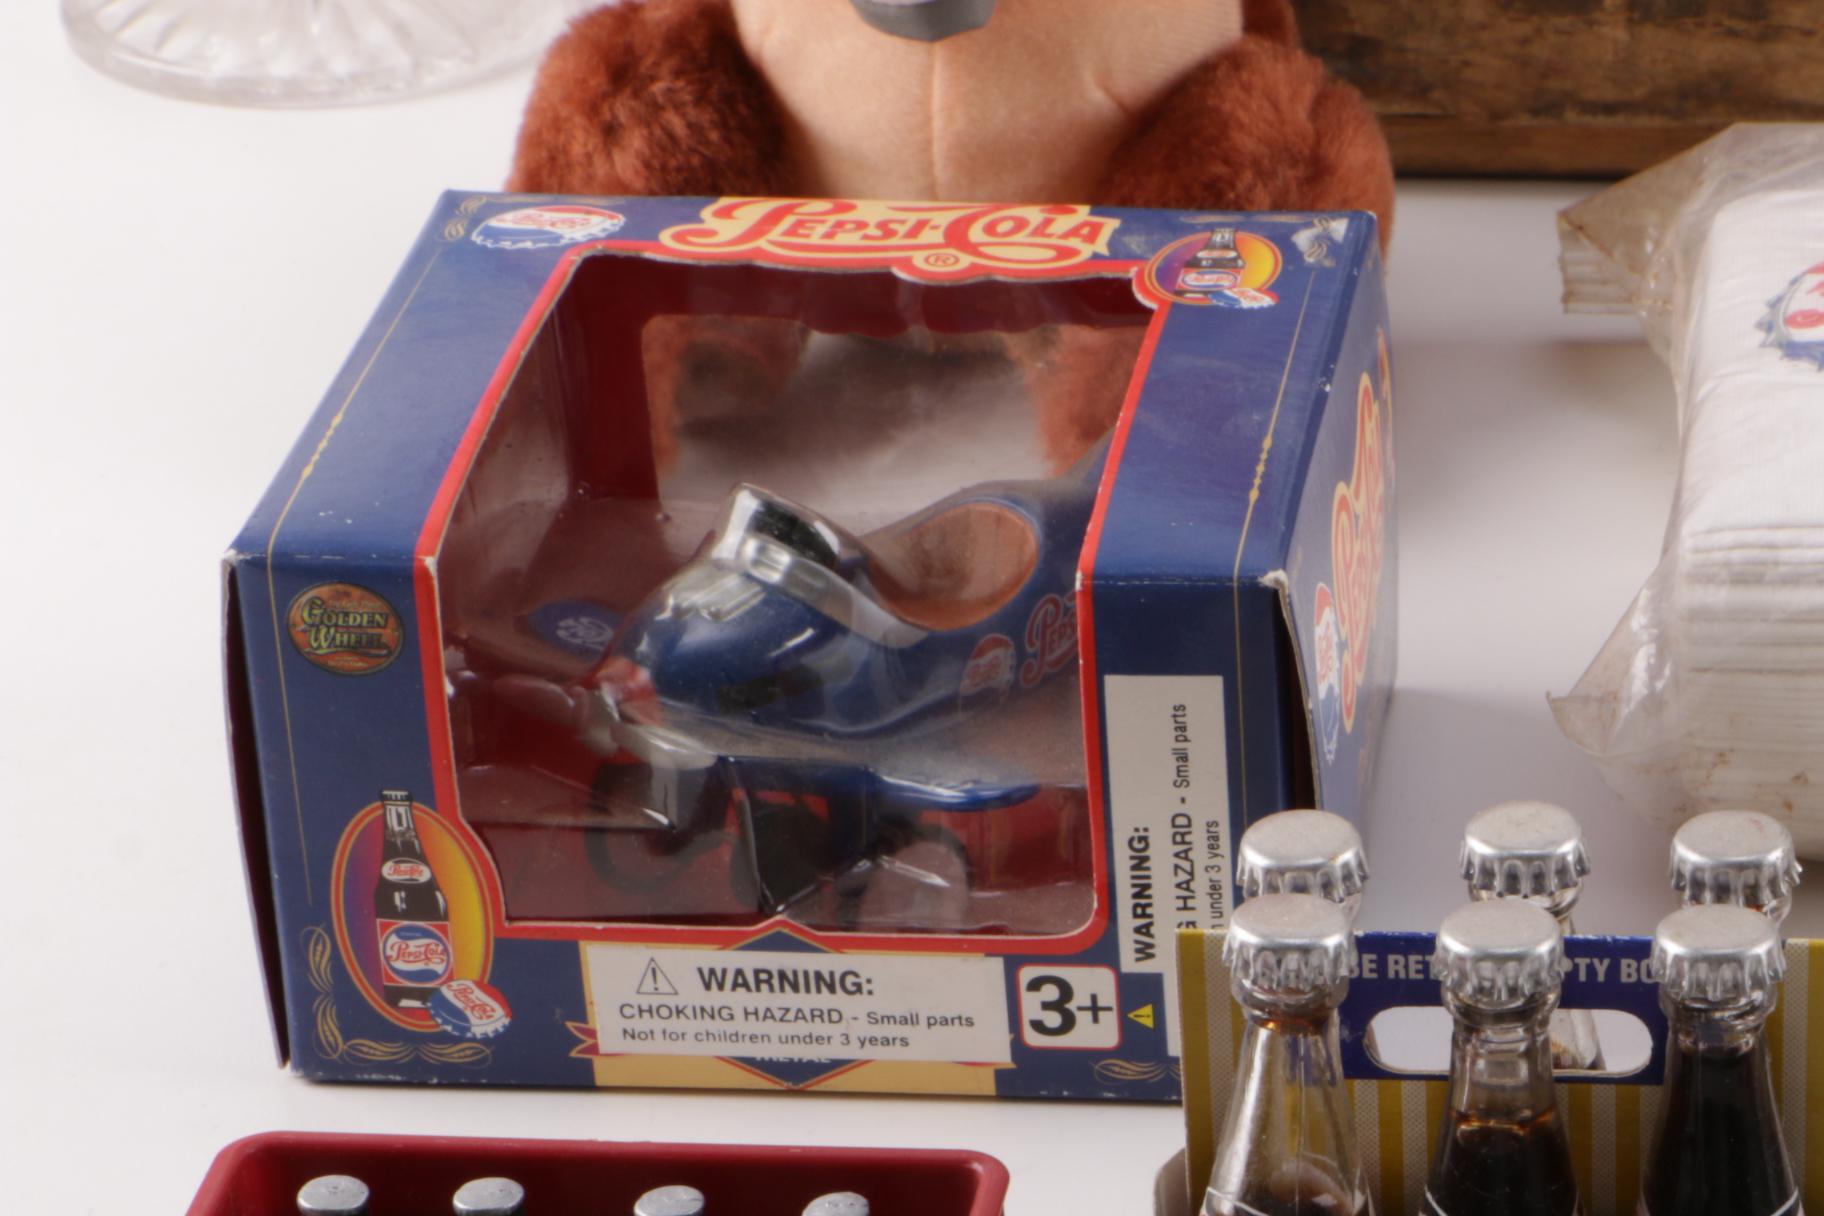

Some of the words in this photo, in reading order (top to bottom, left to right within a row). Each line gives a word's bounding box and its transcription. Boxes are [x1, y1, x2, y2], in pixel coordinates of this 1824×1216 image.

[302, 597, 388, 627] GOLDEN
[1171, 704, 1192, 744] parts
[1173, 748, 1190, 789] Small
[1206, 820, 1225, 860] years
[1171, 811, 1197, 911] HAZARD
[1206, 861, 1220, 873] 3
[1128, 825, 1157, 963] WARNING:
[1205, 875, 1223, 920] under
[697, 966, 874, 996] WARNING:
[619, 1003, 735, 1023] CHOKING
[743, 1006, 844, 1025] HAZARD
[866, 1011, 921, 1028] Small
[926, 1012, 975, 1029] parts
[1024, 973, 1114, 1037] 3+
[621, 1027, 655, 1042] Not
[661, 1027, 689, 1043] for
[694, 1028, 772, 1045] children
[778, 1030, 834, 1047] under
[840, 1032, 851, 1047] 3
[856, 1034, 910, 1050] years
